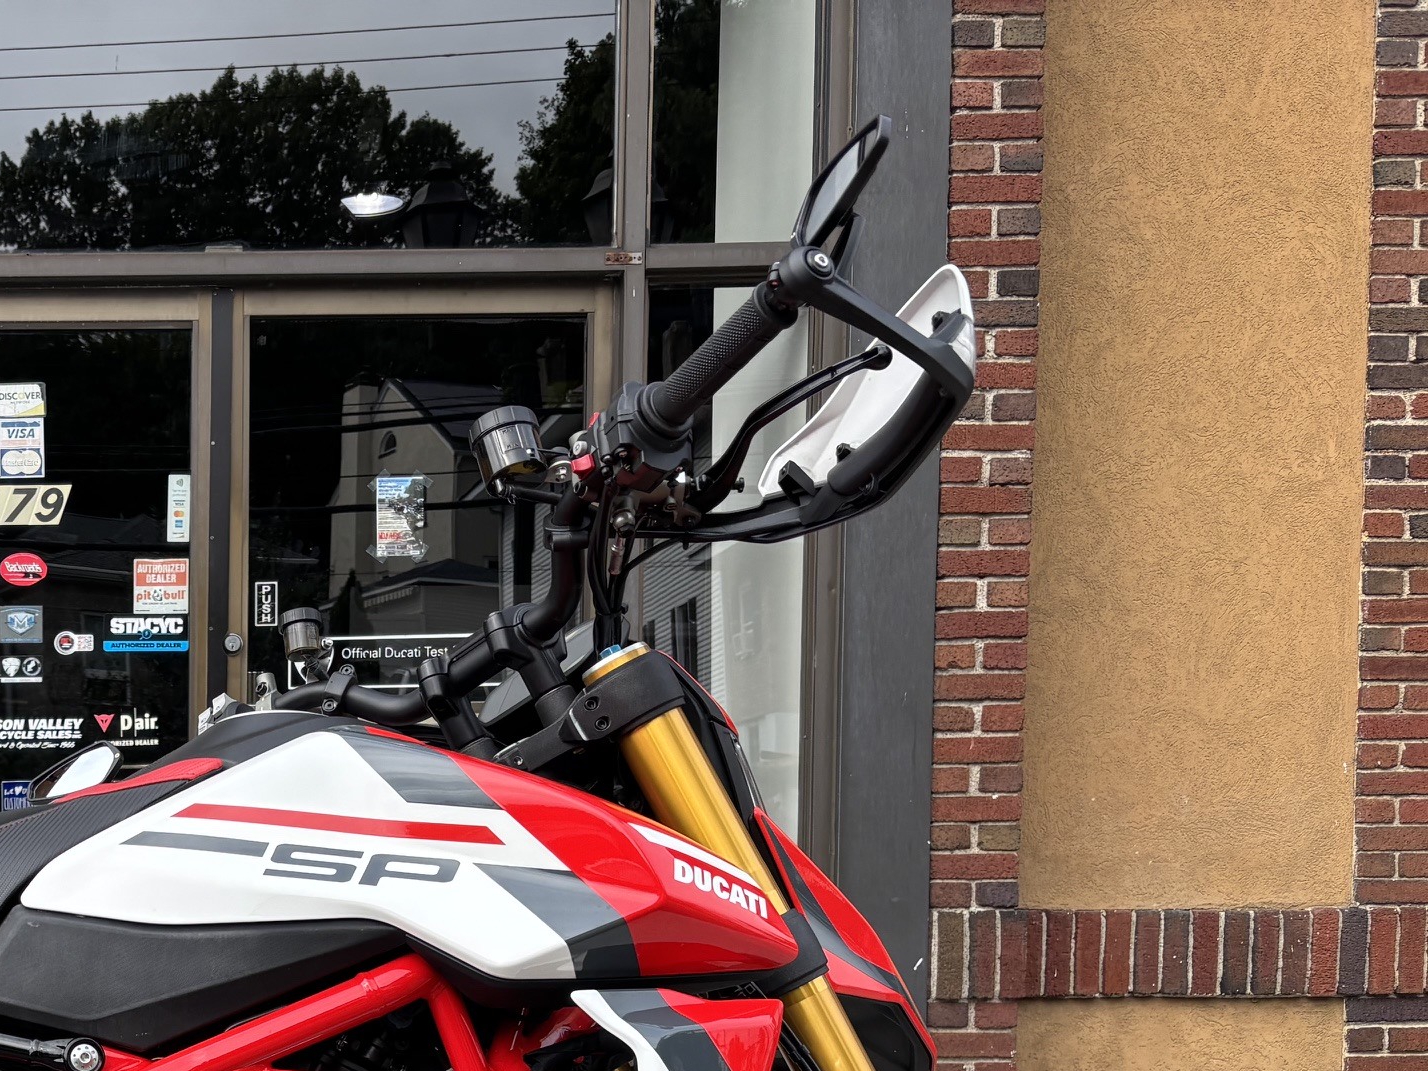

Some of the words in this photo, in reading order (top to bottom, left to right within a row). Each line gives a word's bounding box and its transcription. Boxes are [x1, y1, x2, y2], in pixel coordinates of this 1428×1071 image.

[0, 392, 41, 400] DISCOVER
[7, 428, 35, 439] VISA
[4, 562, 43, 573] Backroads
[137, 564, 186, 573] AUTHORIZED
[145, 574, 177, 584] DEALER
[136, 590, 152, 603] pit
[163, 590, 185, 600] bull
[262, 585, 272, 623] PUSH
[109, 617, 184, 635] STACYC
[341, 647, 381, 660] Official
[384, 646, 421, 659] Ducati
[424, 646, 449, 658] Test
[28, 718, 84, 730] VALLEY
[36, 730, 72, 739] SALES
[263, 843, 461, 887] SP
[673, 857, 768, 919] DUCATI
